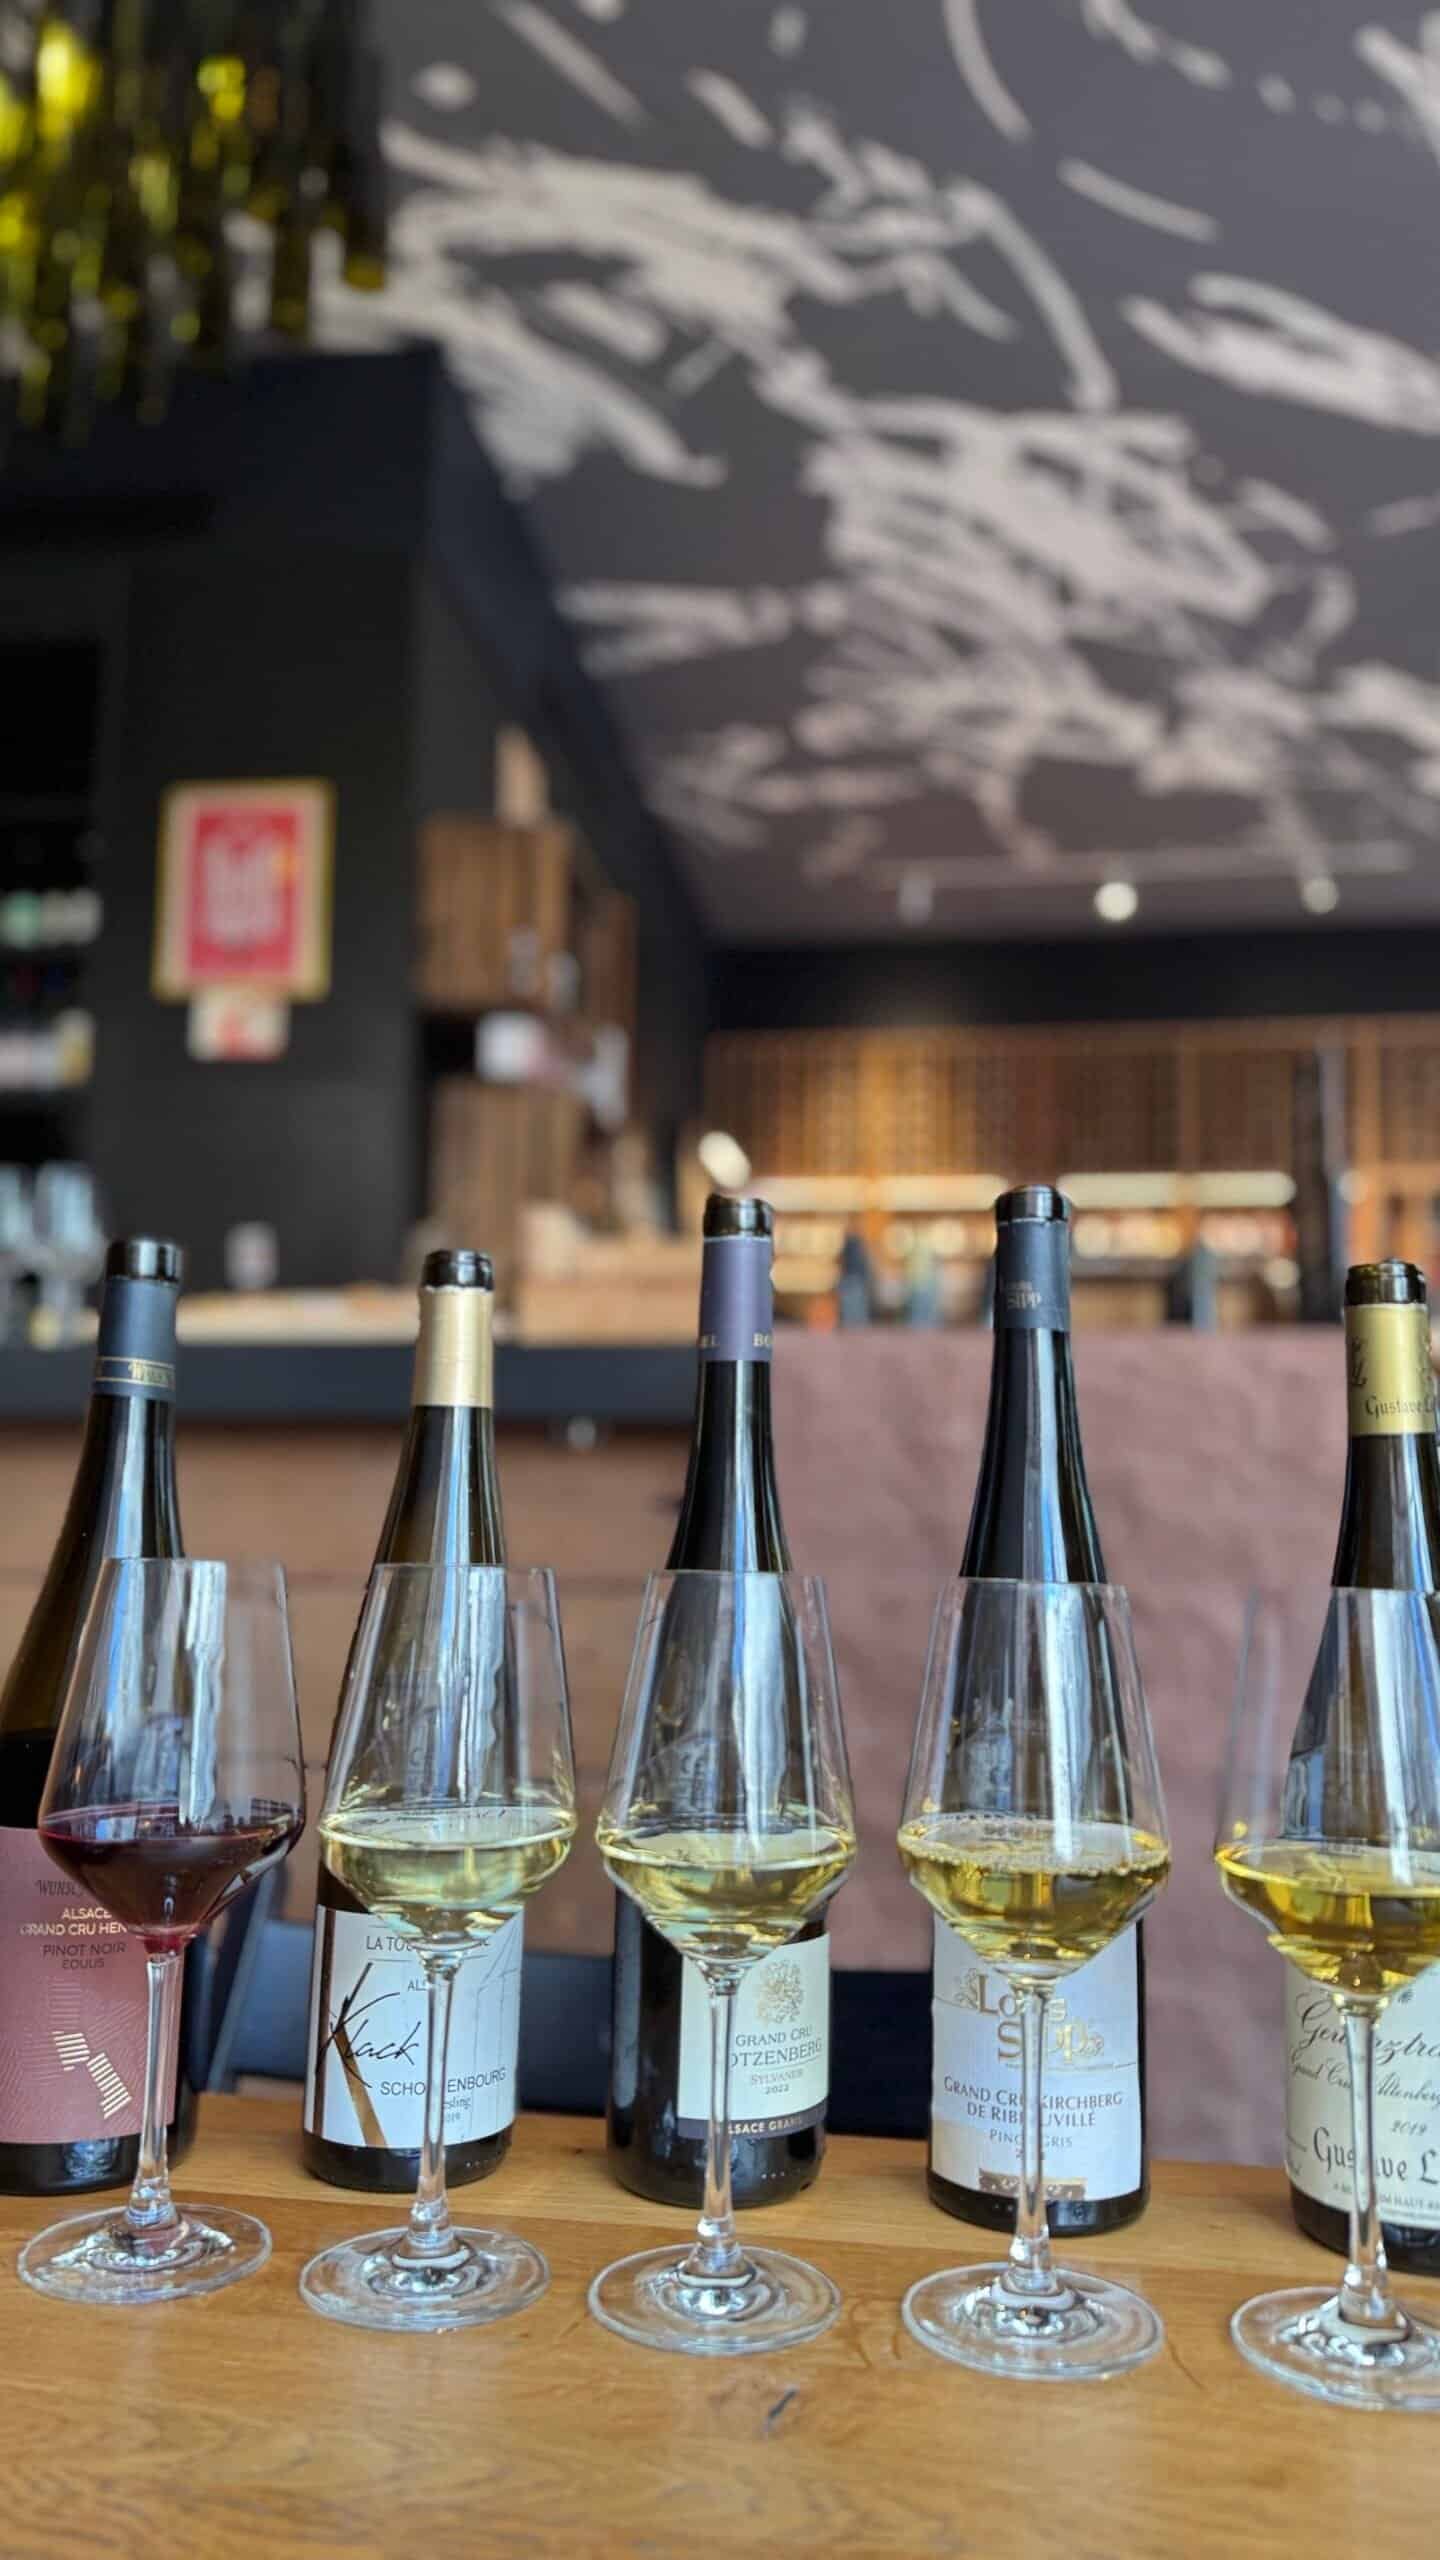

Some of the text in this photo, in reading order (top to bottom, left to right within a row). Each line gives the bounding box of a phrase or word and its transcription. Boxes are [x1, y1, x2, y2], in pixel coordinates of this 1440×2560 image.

[68, 1923, 96, 1936] CRU
[42, 1942, 126, 1957] PINOT NOIR
[366, 1936, 383, 1950] LA
[735, 2031, 786, 2047] GRAND
[730, 2037, 822, 2068] OTZENBERG
[943, 2075, 991, 2102] GRAND
[967, 2101, 986, 2118] DE
[728, 2121, 765, 2135] LSACE
[988, 2128, 1024, 2145] PINO
